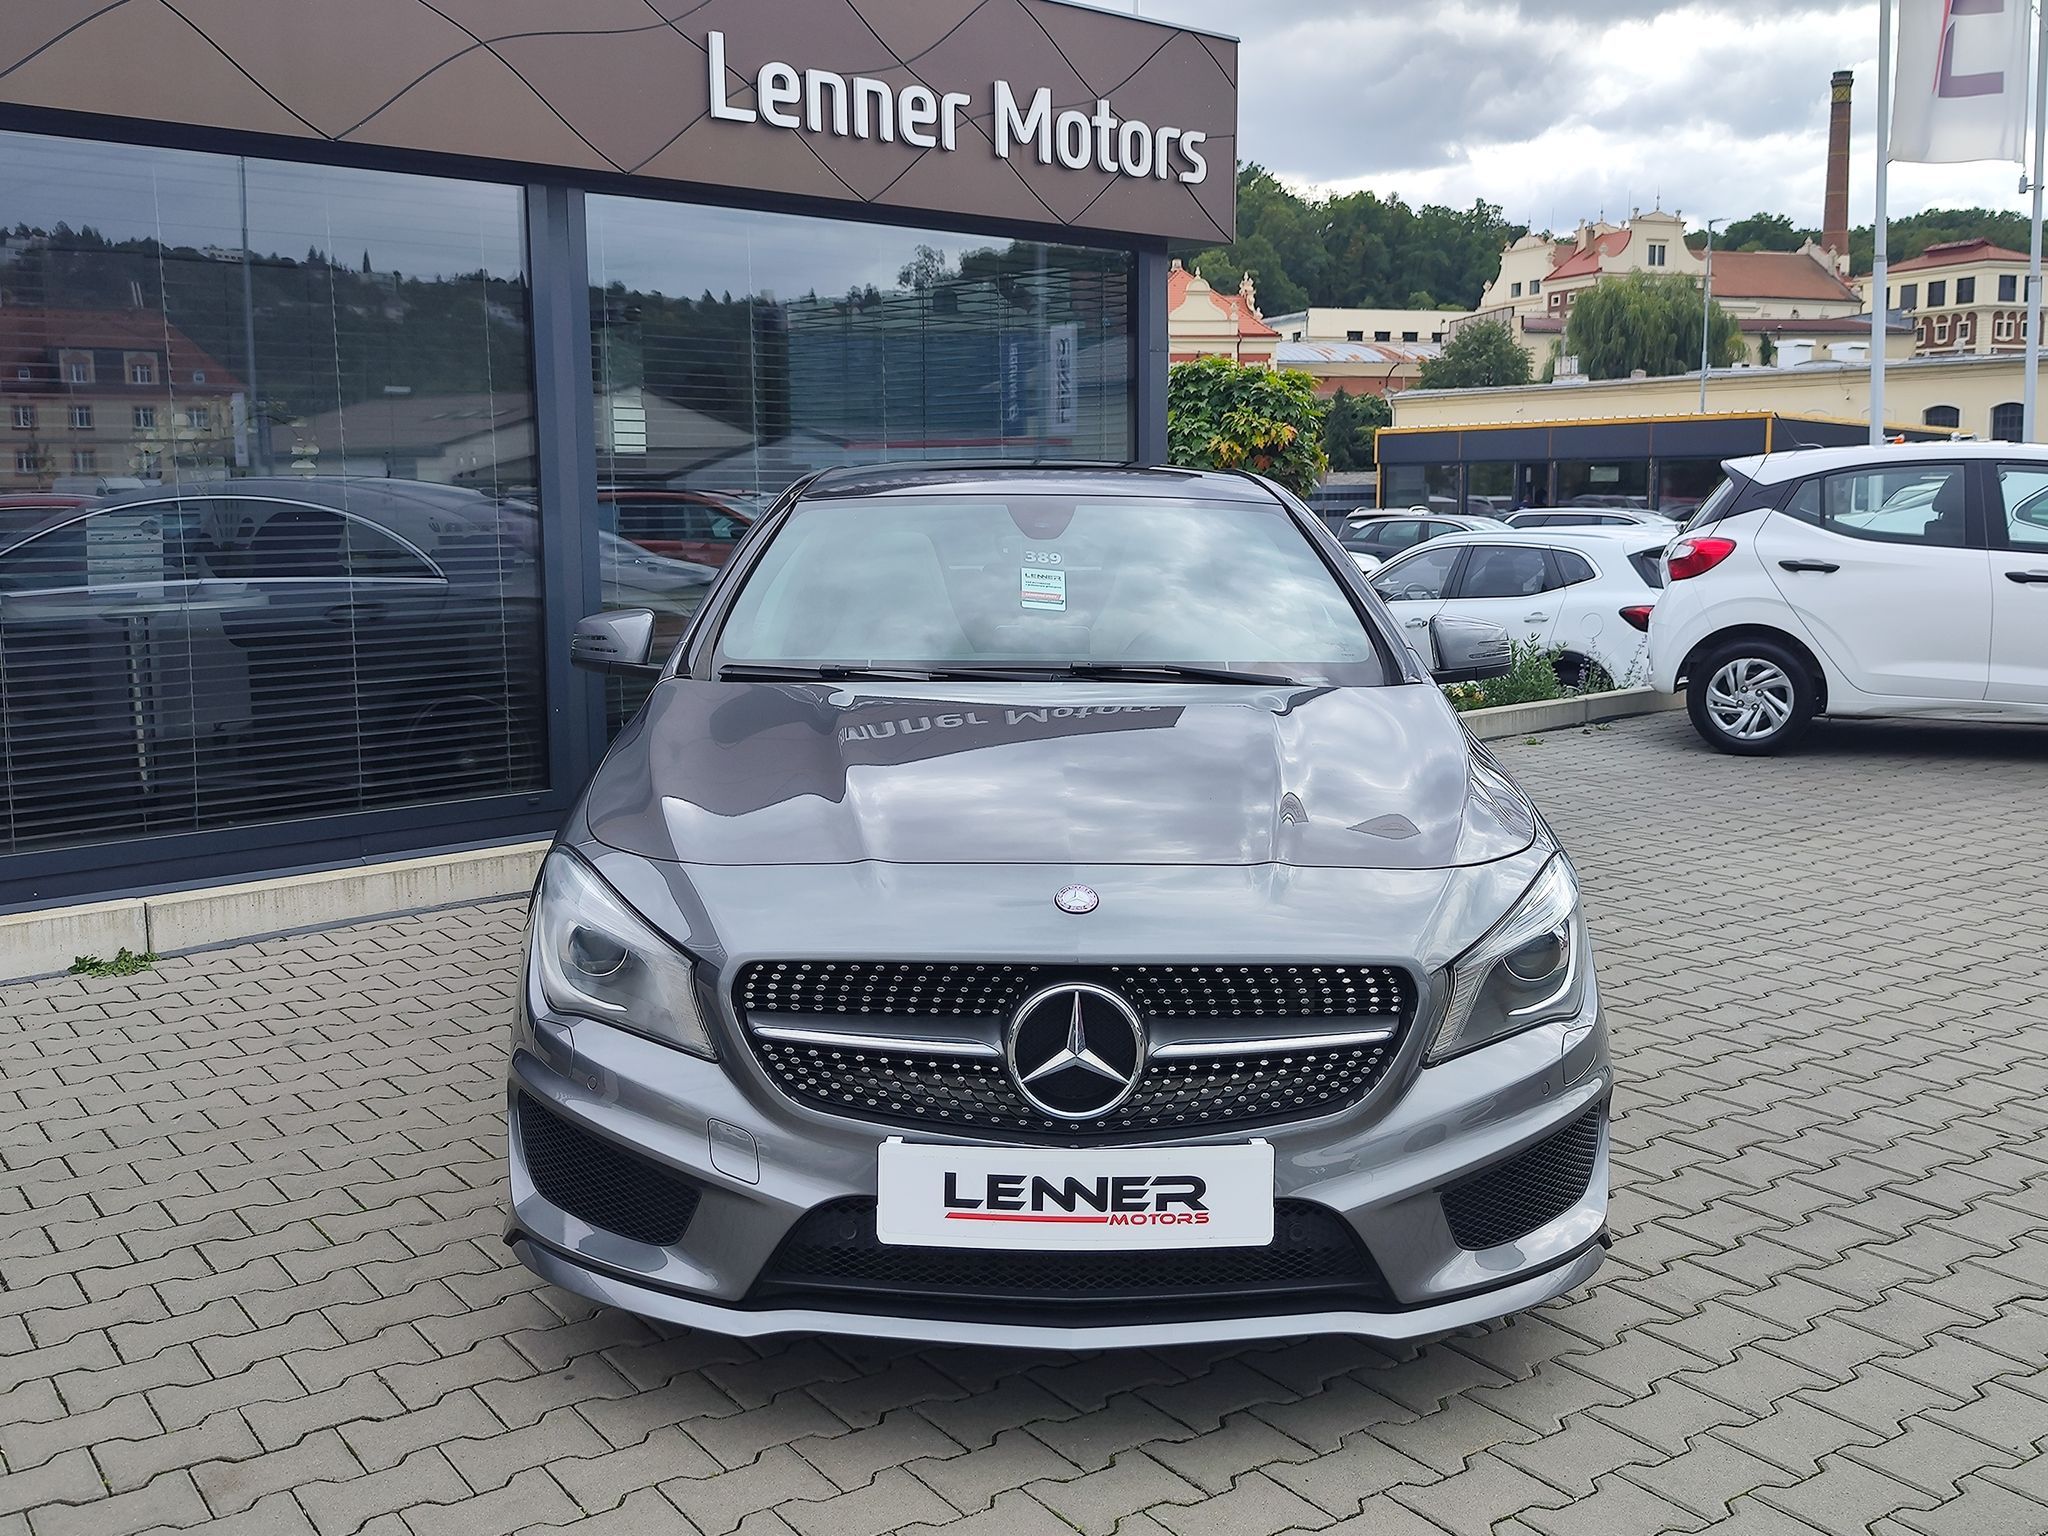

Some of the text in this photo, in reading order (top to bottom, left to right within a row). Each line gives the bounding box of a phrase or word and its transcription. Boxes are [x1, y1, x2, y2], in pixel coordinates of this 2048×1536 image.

[707, 31, 1208, 185] Lenner Motors
[1024, 551, 1062, 565] 389
[943, 1171, 1209, 1212] LENNER
[1108, 1211, 1211, 1227] MOTORS
